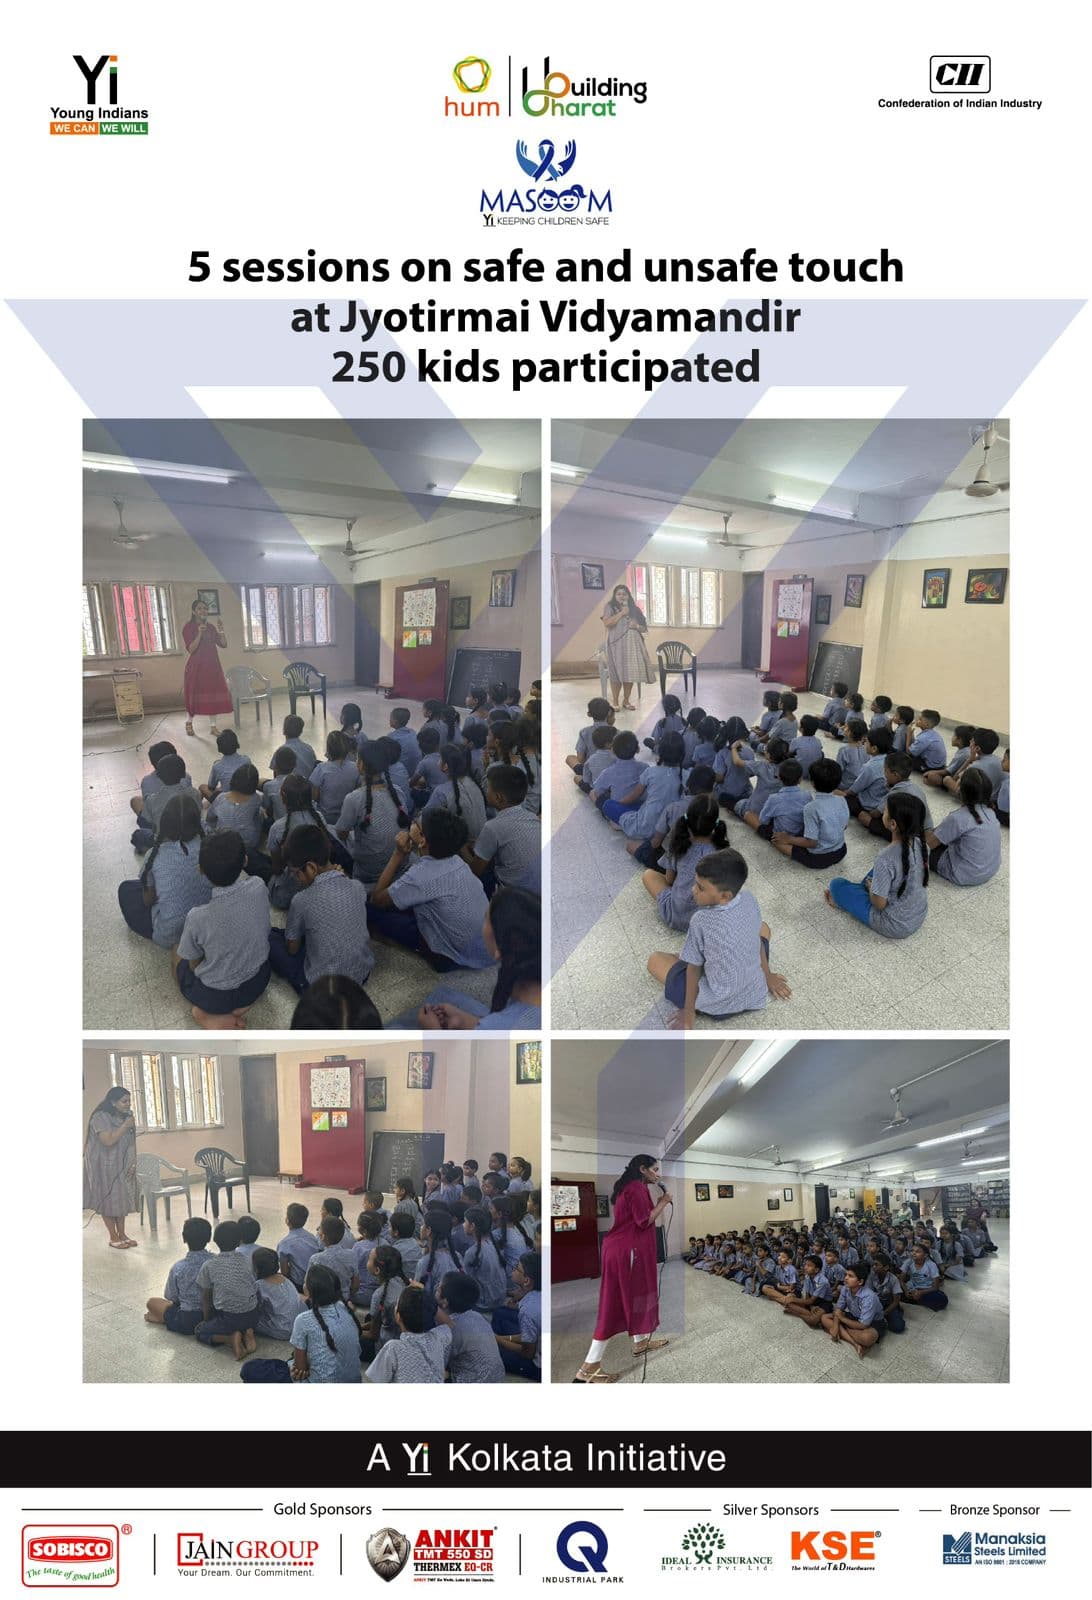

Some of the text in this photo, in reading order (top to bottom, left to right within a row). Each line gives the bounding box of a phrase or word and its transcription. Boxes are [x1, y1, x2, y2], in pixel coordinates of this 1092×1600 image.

[73, 55, 117, 104] Yi
[936, 63, 985, 85] CII
[445, 96, 499, 116] hum
[878, 99, 1042, 109] Confederation of Indian Industry
[50, 107, 149, 121] Young Indians
[54, 124, 146, 132] WE CAN WE WILL
[497, 217, 535, 225] KEEPING
[538, 217, 583, 225] CHILDREN
[585, 217, 609, 225] SAFE
[188, 248, 903, 282] 5 sessions on safe and unsafe touch
[291, 299, 801, 342] at Jyotirmai Vidyamandir
[332, 349, 760, 391] 250 kids participated
[366, 1442, 727, 1475] A Yi Kolkata Initiative
[274, 1502, 372, 1518] Gold Sponsors
[723, 1503, 819, 1518] Silver Sponsors
[950, 1503, 1040, 1517] Bronze Sponsor
[415, 1530, 494, 1547] ANKIT
[975, 1532, 1046, 1544] Manaksia
[32, 1543, 108, 1556] SOBISCO
[791, 1531, 876, 1560] KSE
[975, 1547, 1046, 1556] Steels Limited
[415, 1550, 492, 1559] TMT 550 SD
[662, 1557, 692, 1565] IDEAL
[26, 1568, 41, 1578] The
[44, 1567, 63, 1576] taste
[92, 1567, 115, 1580] health
[178, 1568, 315, 1577] Your Dream. Our Commitment.
[414, 1562, 461, 1572] THERMEX
